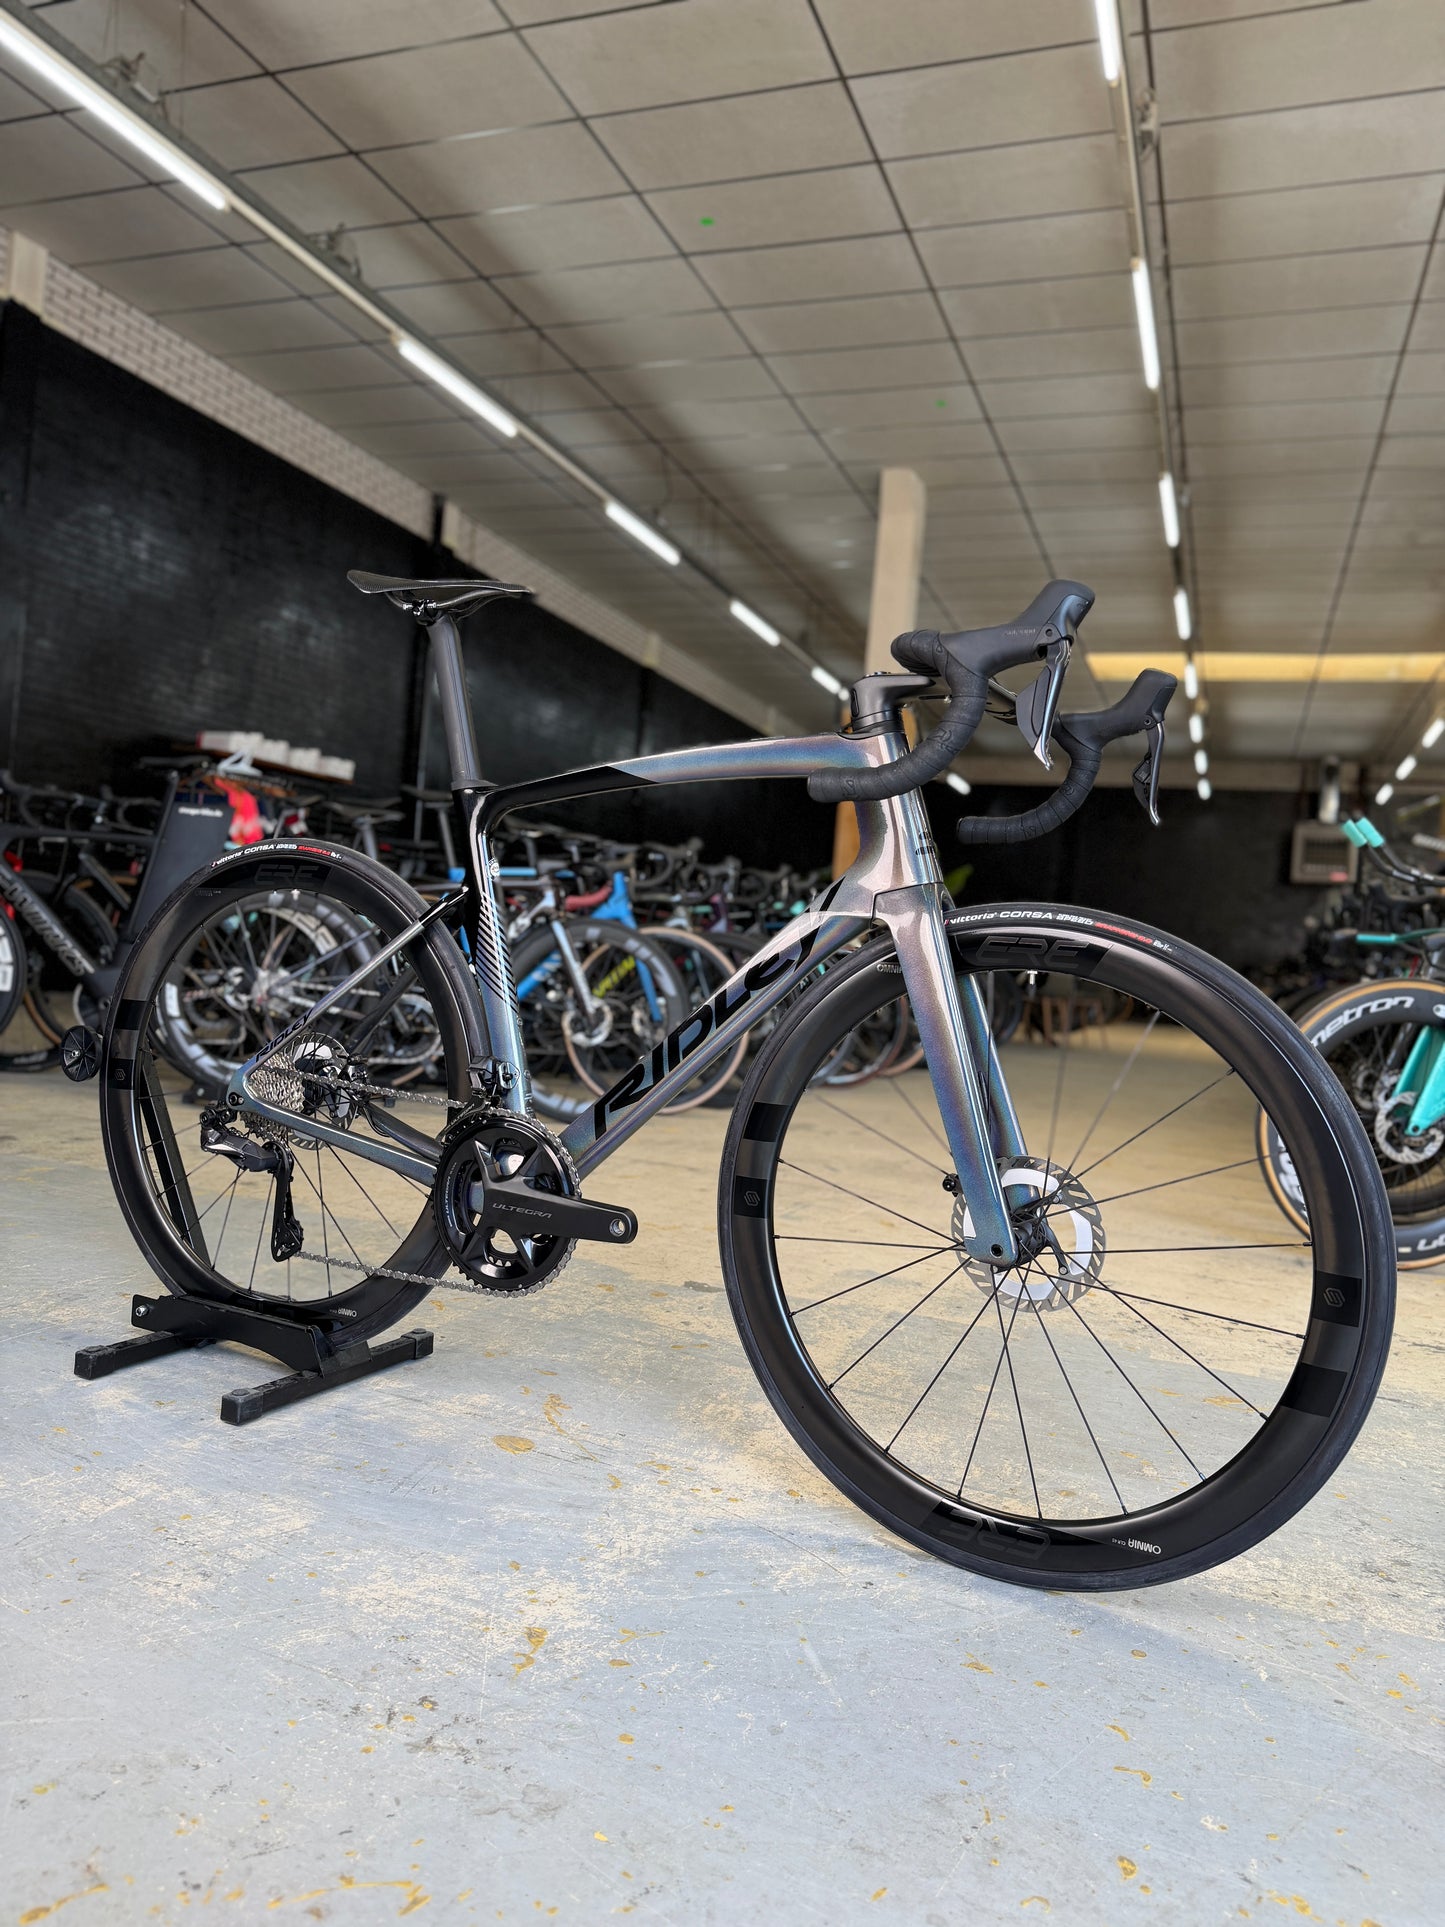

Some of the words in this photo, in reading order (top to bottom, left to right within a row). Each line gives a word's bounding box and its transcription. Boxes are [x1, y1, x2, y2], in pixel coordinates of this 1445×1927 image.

[244, 844, 275, 855] CORSA
[950, 912, 996, 925] vittoria
[1000, 911, 1053, 920] CORSA
[976, 935, 1090, 968] ERE
[255, 1008, 313, 1062] RIDLEY
[492, 1203, 553, 1219] ULTEGRA
[1127, 1537, 1162, 1555] OMNIA
